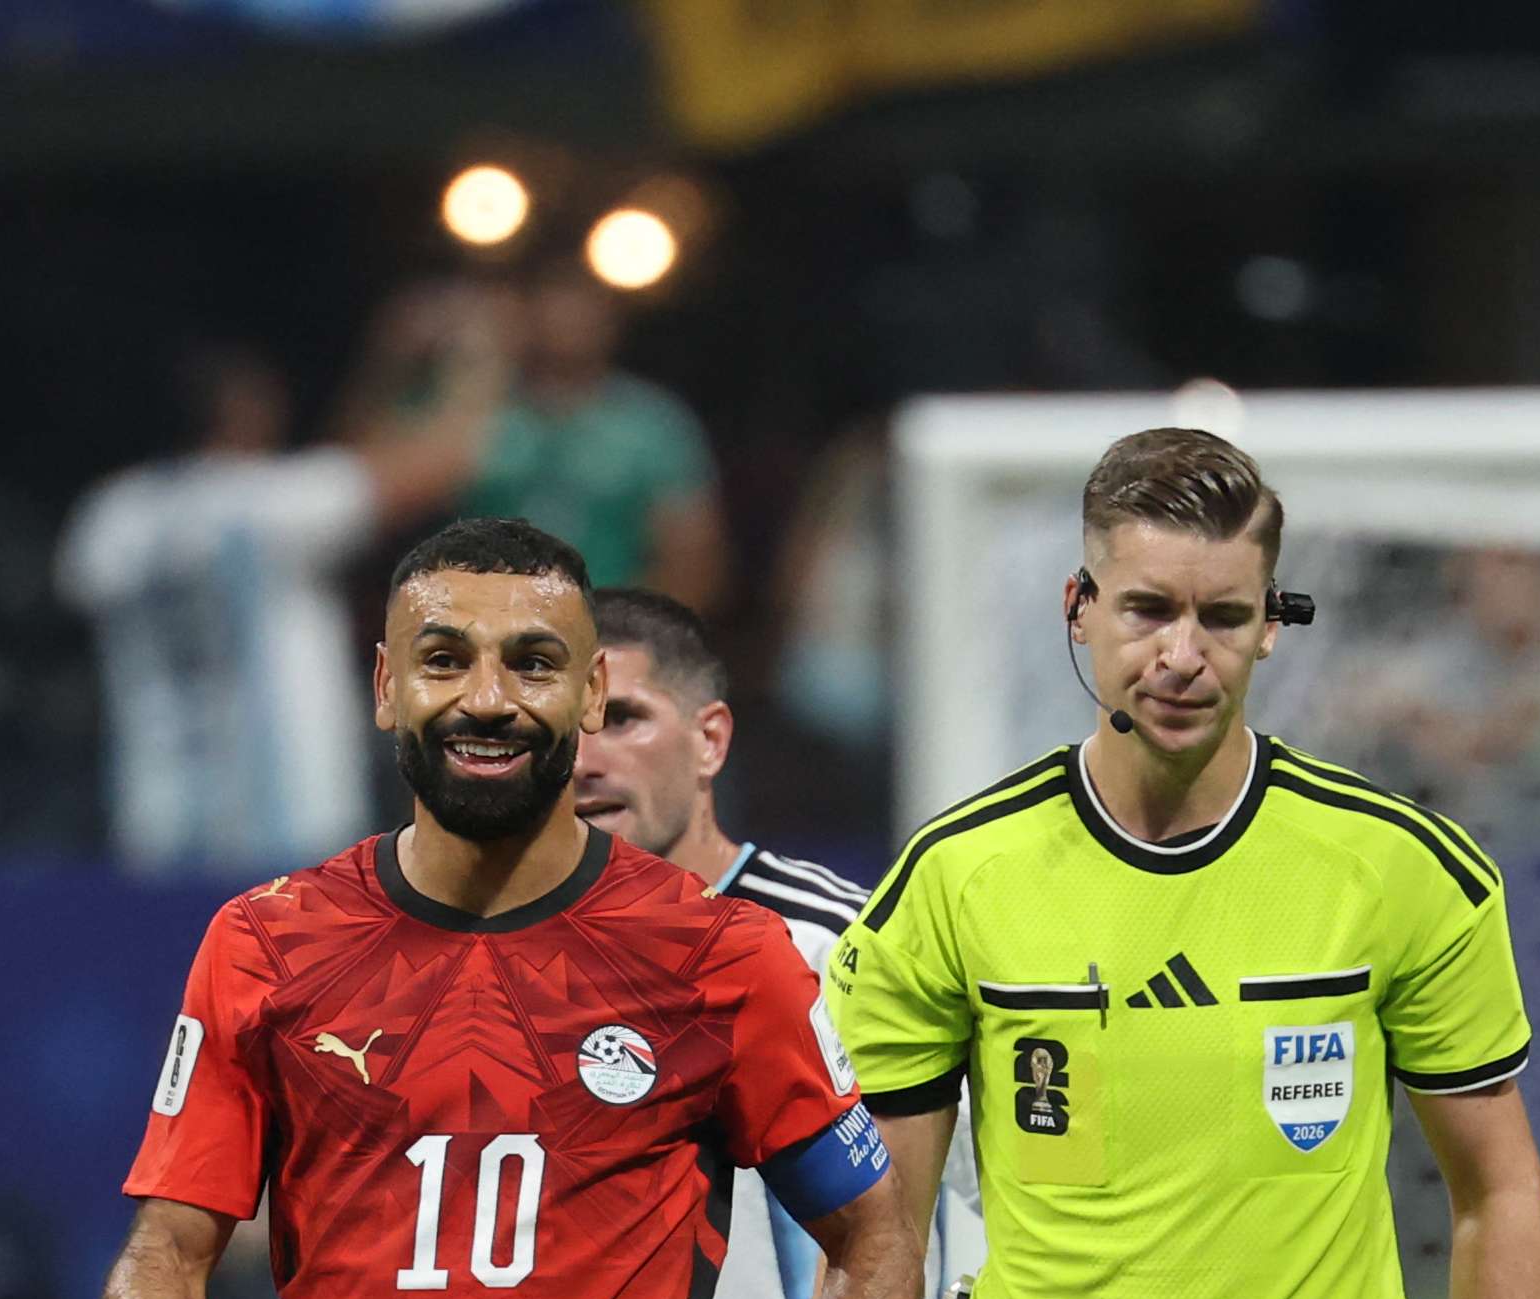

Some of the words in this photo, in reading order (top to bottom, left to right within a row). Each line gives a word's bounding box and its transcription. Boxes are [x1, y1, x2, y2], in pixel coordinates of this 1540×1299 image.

[1274, 1031, 1346, 1066] FIFA
[1270, 1082, 1344, 1101] REFEREE
[1029, 1114, 1056, 1127] FIFA
[1292, 1125, 1325, 1141] 2026
[397, 1134, 545, 1289] 10
